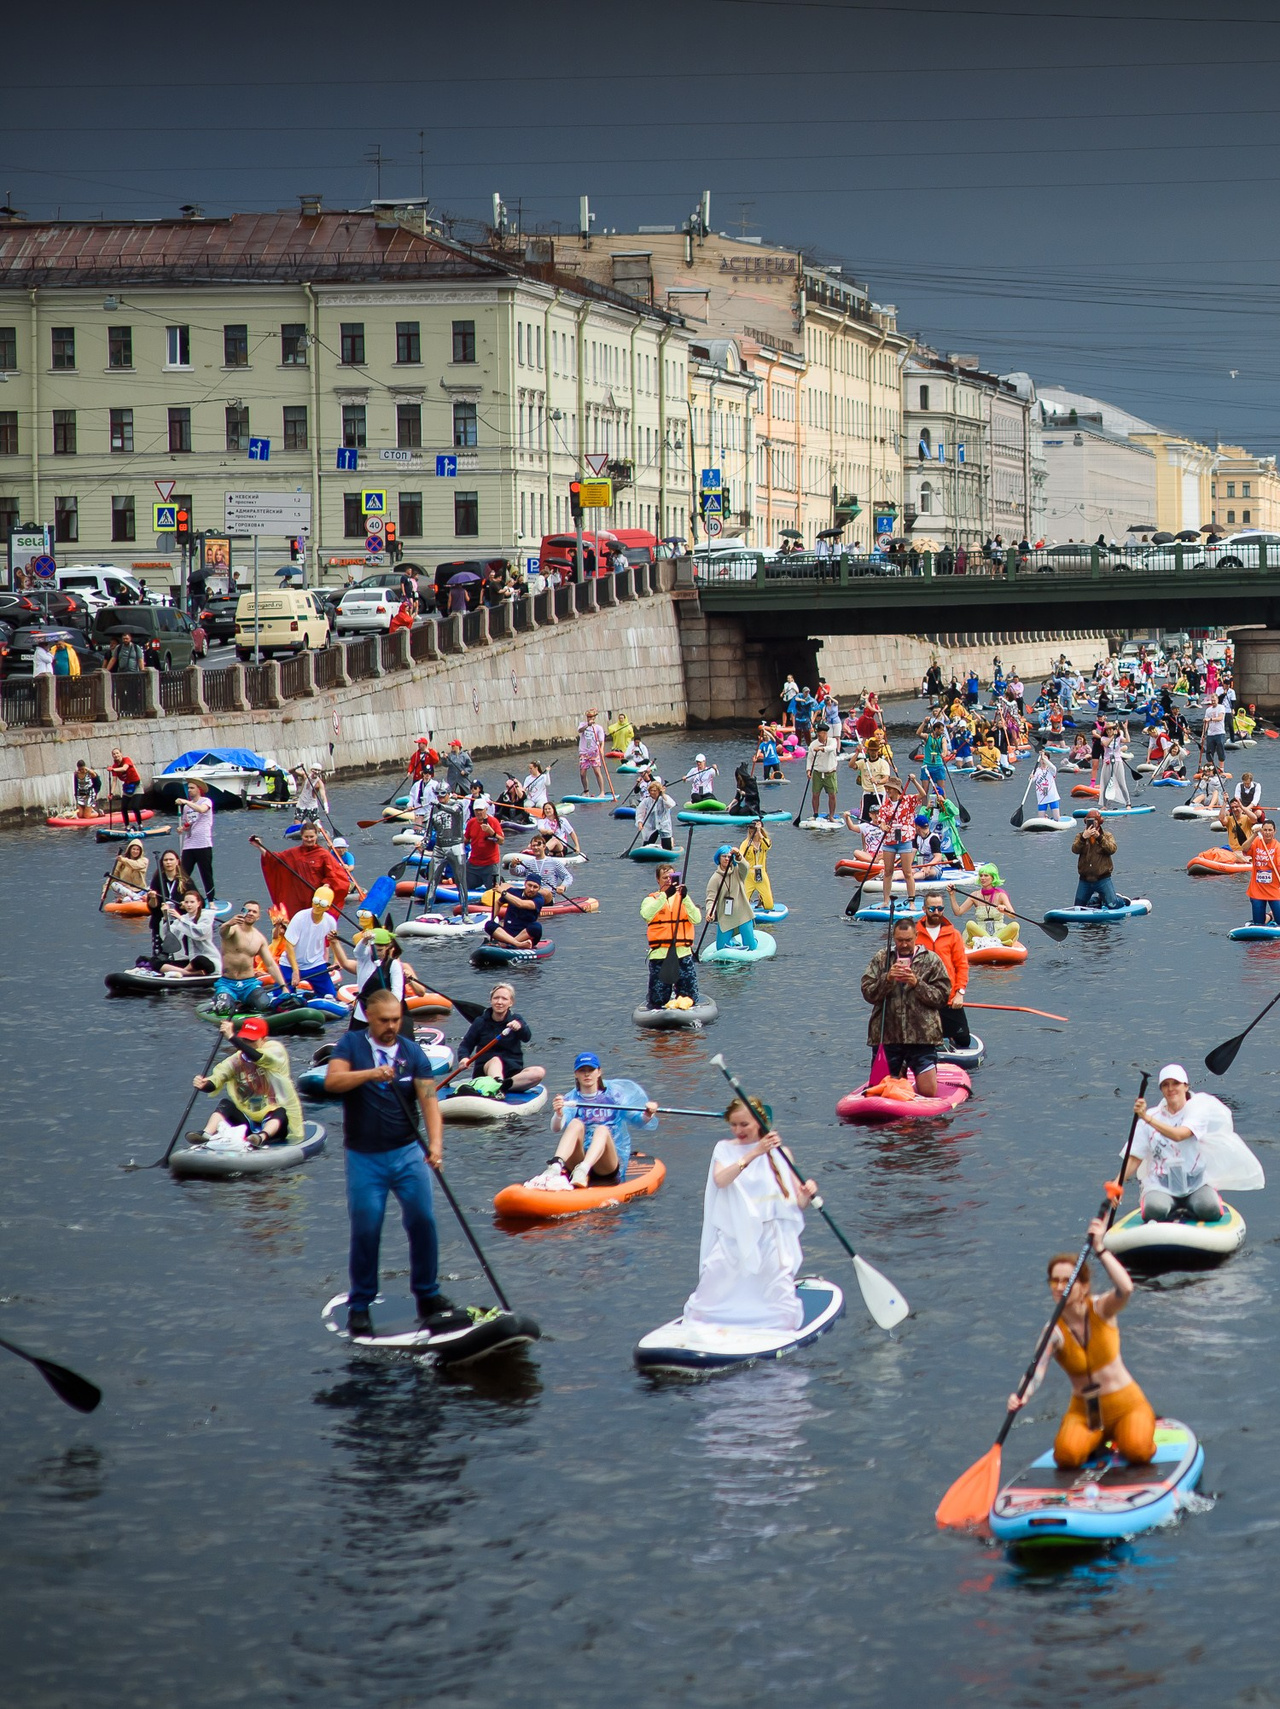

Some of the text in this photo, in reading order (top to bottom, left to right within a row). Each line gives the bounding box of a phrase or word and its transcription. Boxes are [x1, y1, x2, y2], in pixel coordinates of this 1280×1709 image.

[383, 451, 407, 460] СТОП
[369, 521, 380, 529] 40
[17, 537, 44, 547] sela
